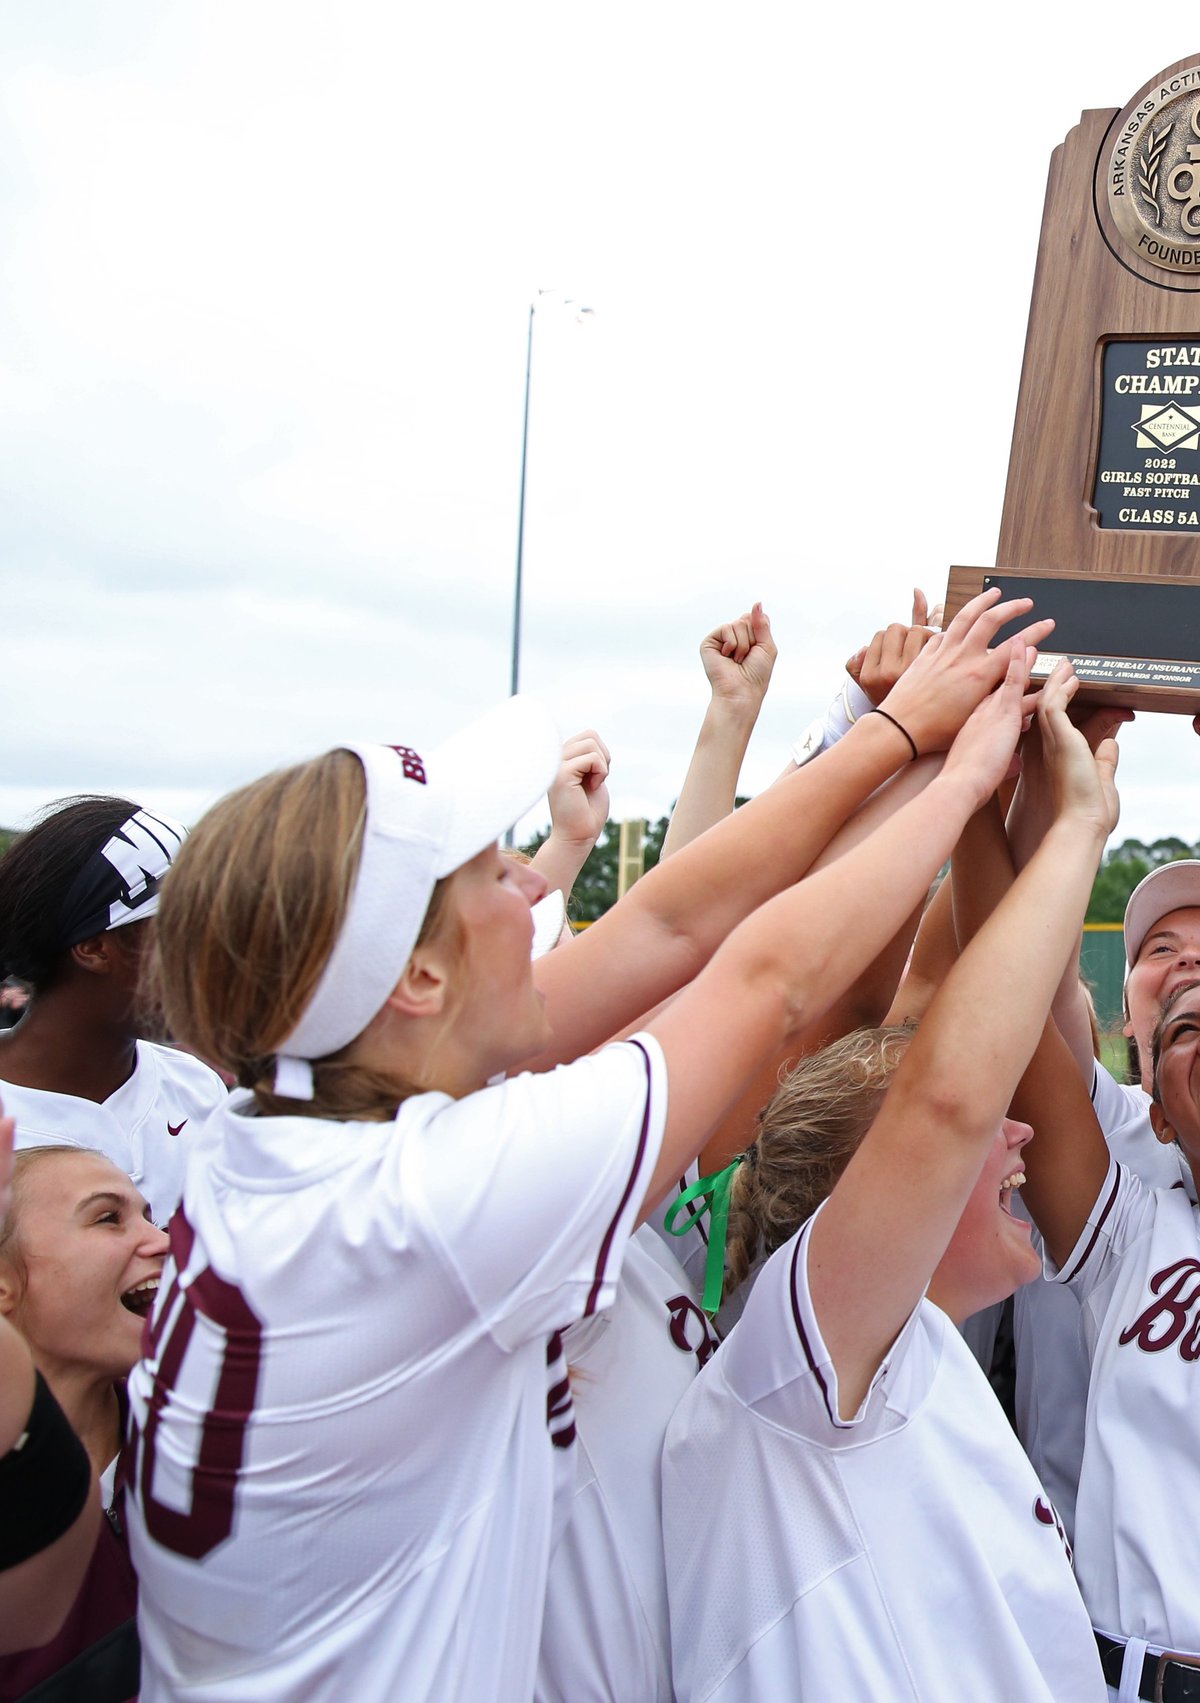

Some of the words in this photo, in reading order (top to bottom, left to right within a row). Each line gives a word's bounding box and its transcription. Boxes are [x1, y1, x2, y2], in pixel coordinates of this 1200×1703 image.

[1112, 100, 1156, 196] ARKANSAS
[1148, 422, 1191, 432] CENTENNIAL
[1144, 458, 1176, 469] 2022
[1100, 471, 1143, 484] GIRLS
[1122, 487, 1152, 498] FAST
[1153, 488, 1190, 499] PITCH
[1118, 508, 1175, 524] CLASS
[1177, 511, 1200, 526] 5A
[1071, 658, 1101, 669] FARM
[1102, 660, 1145, 671] BUREAU
[1075, 668, 1114, 678] OFFICIAL
[1115, 671, 1151, 680] AWARDS
[1152, 674, 1193, 683] SPONSOR
